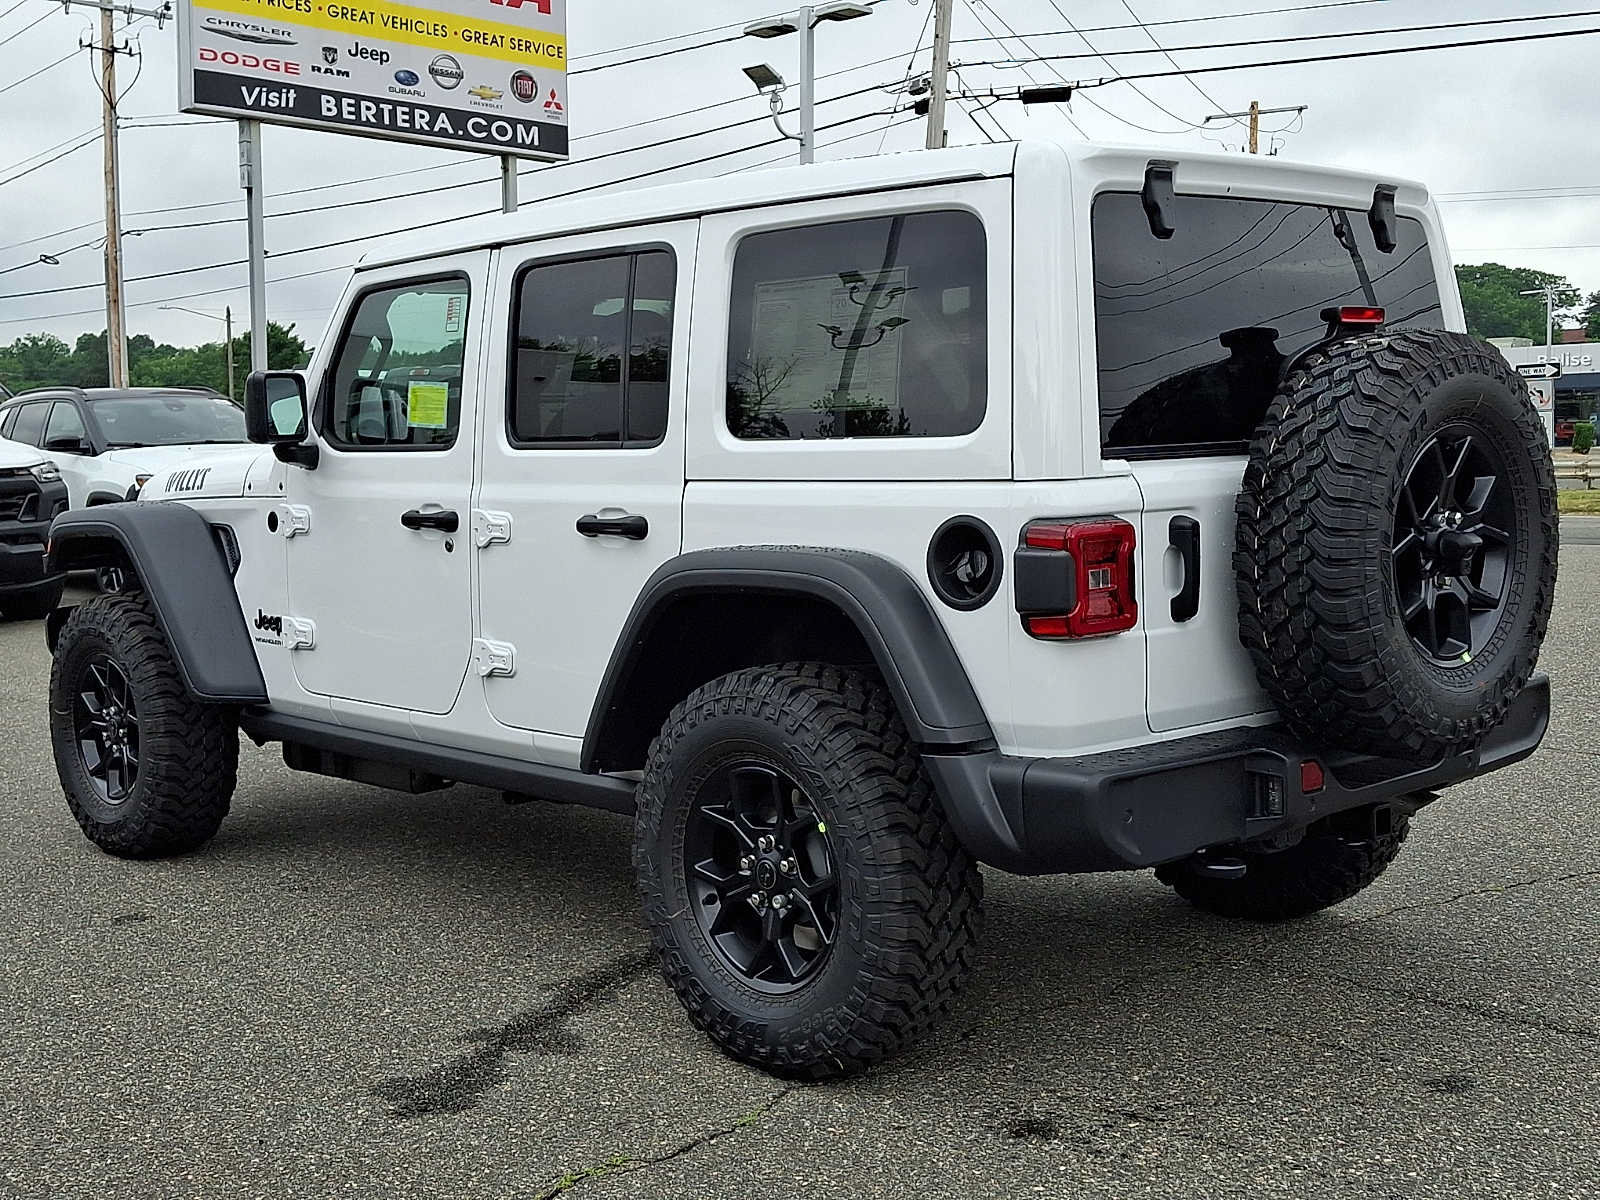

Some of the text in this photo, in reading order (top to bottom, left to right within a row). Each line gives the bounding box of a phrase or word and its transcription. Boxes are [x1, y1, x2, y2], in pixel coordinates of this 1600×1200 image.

[205, 17, 292, 38] CHRYSLER
[327, 4, 376, 25] GREAT
[380, 13, 449, 38] VEHICLES
[461, 28, 506, 48] GREAT
[509, 37, 564, 59] SERVICE
[199, 47, 301, 76] DODGE
[347, 41, 391, 65] Jeep
[311, 64, 351, 78] RAM
[431, 66, 462, 79] NISSAN
[387, 86, 426, 98] SUBARU
[516, 79, 534, 96] FIAT
[240, 86, 540, 146] Visit BERTERA.COM
[1533, 367, 1546, 375] WAY
[254, 608, 283, 637] Jeep
